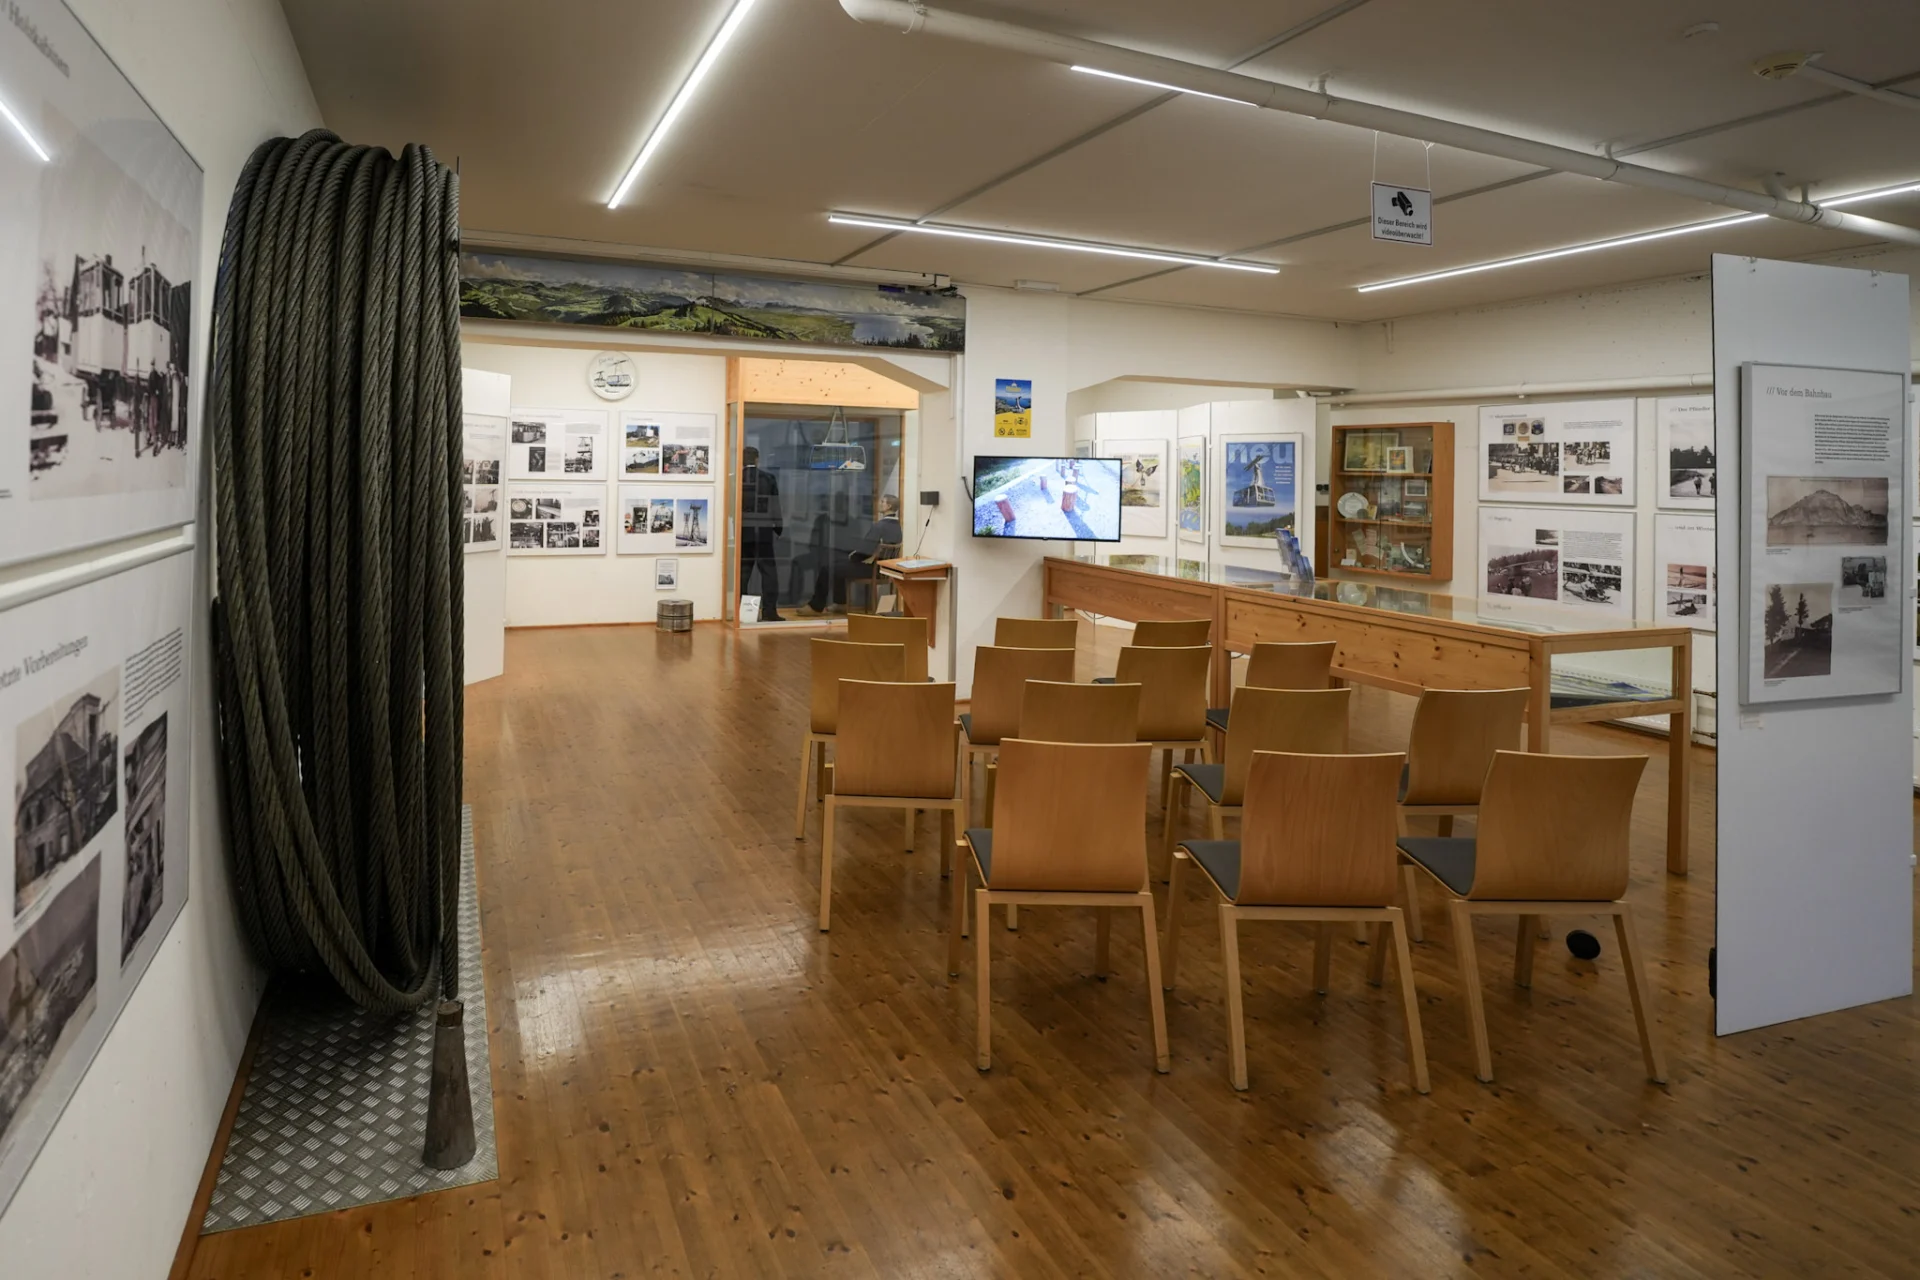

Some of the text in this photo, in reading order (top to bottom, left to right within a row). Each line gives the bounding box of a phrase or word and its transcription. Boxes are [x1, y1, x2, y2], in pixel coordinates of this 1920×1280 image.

[1378, 217, 1394, 225] Dieser
[1396, 219, 1415, 228] Bereich
[1382, 228, 1424, 239] videoüberwacht!
[1777, 387, 1788, 397] Vor
[1789, 387, 1803, 397] dem
[1805, 388, 1832, 399] Bahnbau
[1228, 443, 1294, 465] neu
